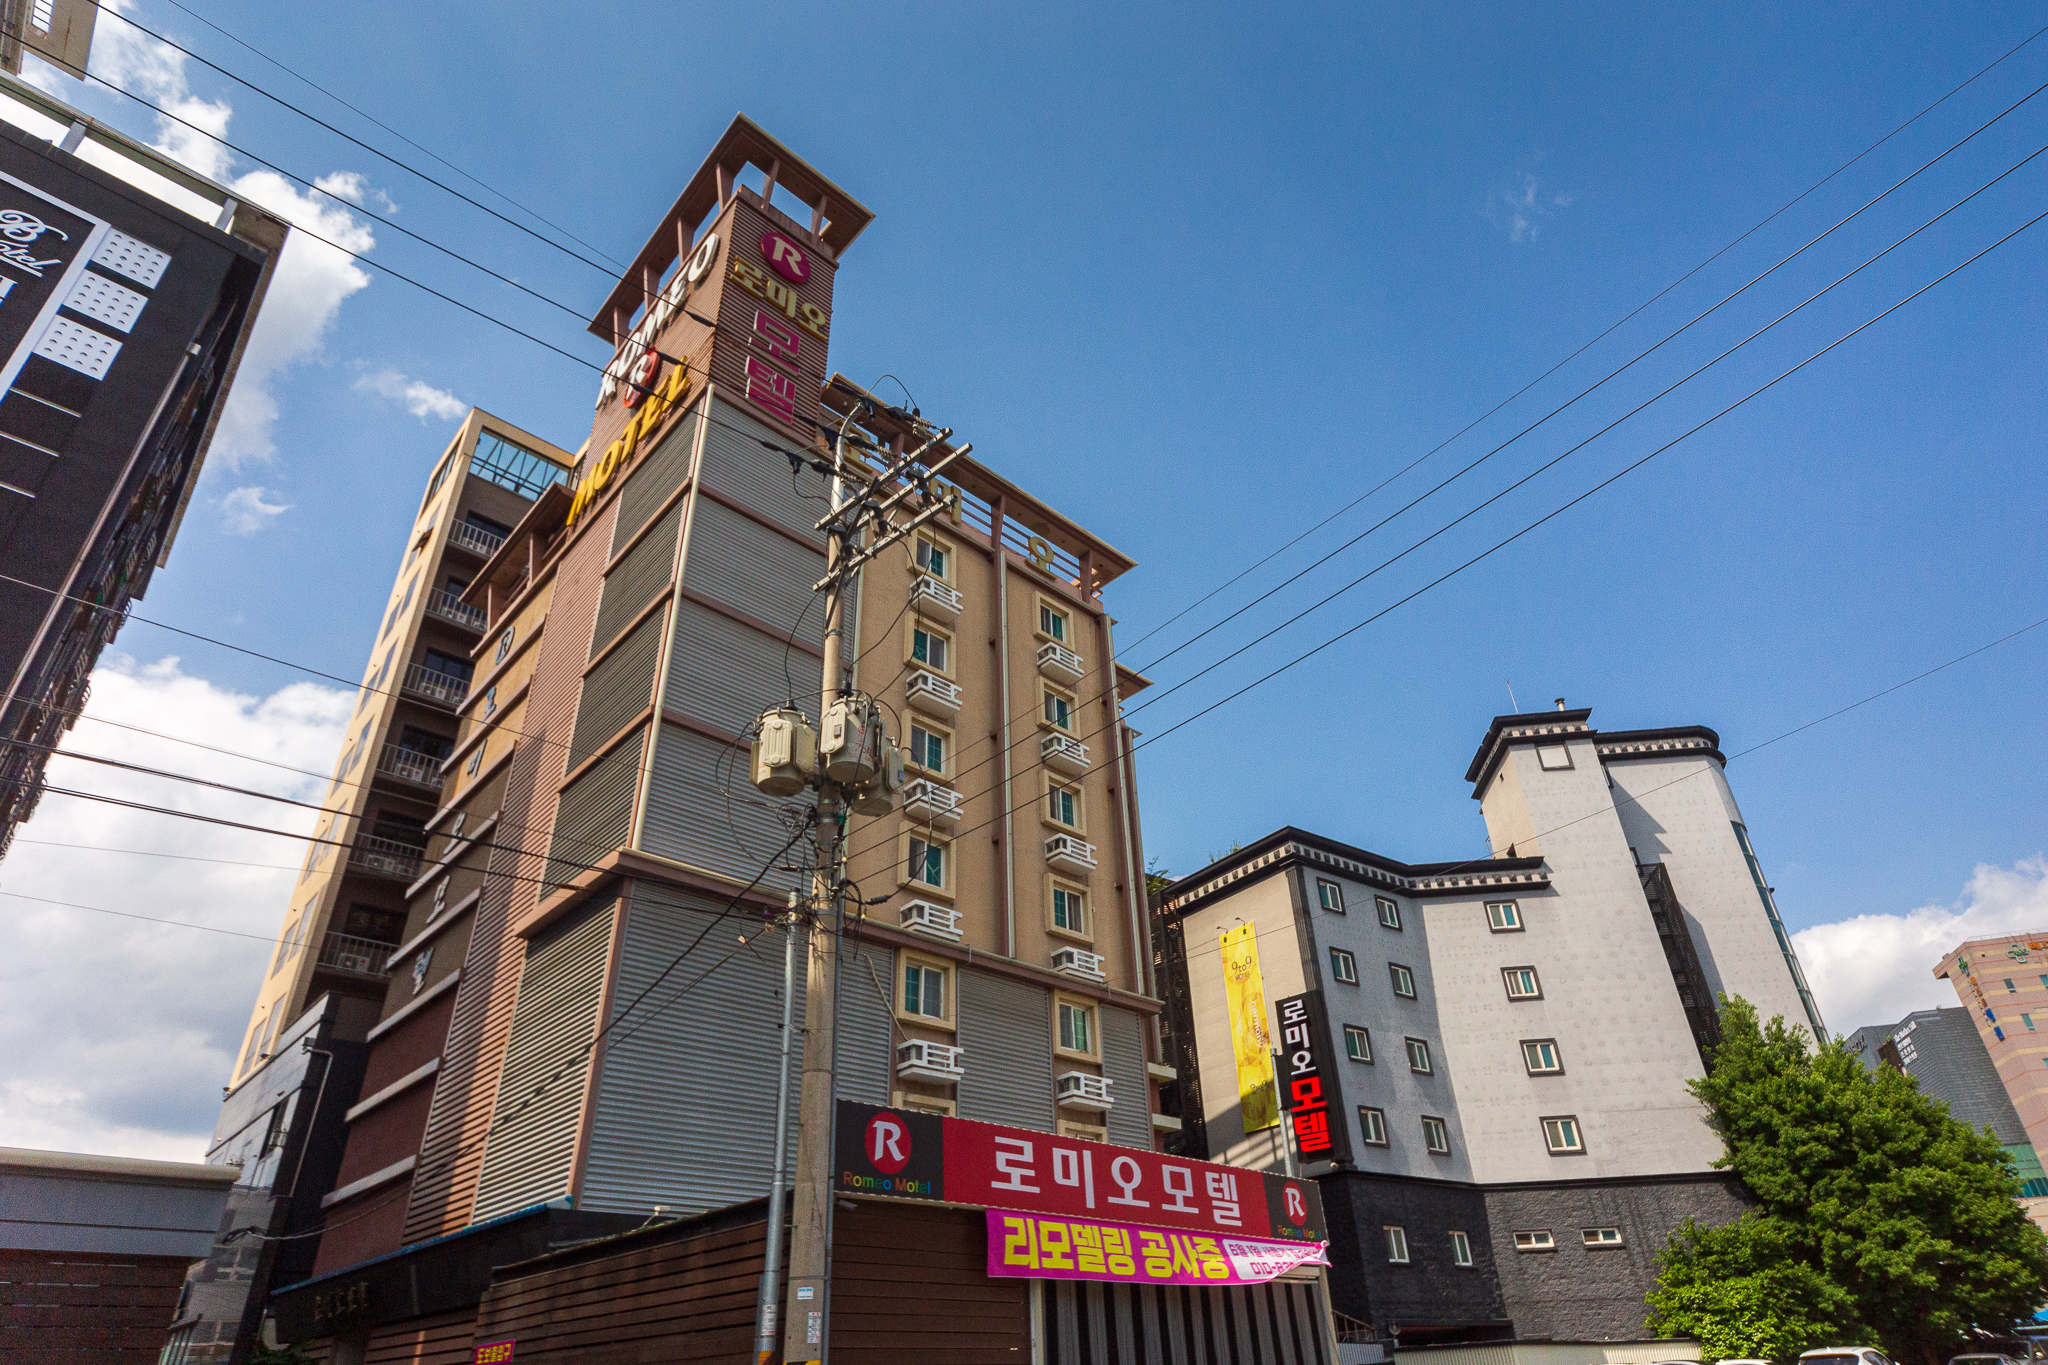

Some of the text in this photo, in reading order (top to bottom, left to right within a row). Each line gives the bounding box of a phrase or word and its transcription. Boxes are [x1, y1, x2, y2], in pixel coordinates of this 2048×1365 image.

[0, 240, 62, 271] otel
[772, 235, 804, 277] R
[596, 232, 719, 410] ROMEO
[730, 254, 829, 342] 로미오
[745, 309, 801, 425] 모텔
[566, 355, 691, 527] MOTEL
[1250, 1000, 1263, 1049] harmony
[872, 1120, 905, 1161] R
[843, 1171, 931, 1194] Romeo Motel
[990, 1135, 1243, 1227] 로미오모텔
[1285, 1187, 1305, 1217] R
[1003, 1216, 1230, 1279] 리모델링 공사중
[1277, 1224, 1322, 1240] Romeo Motel
